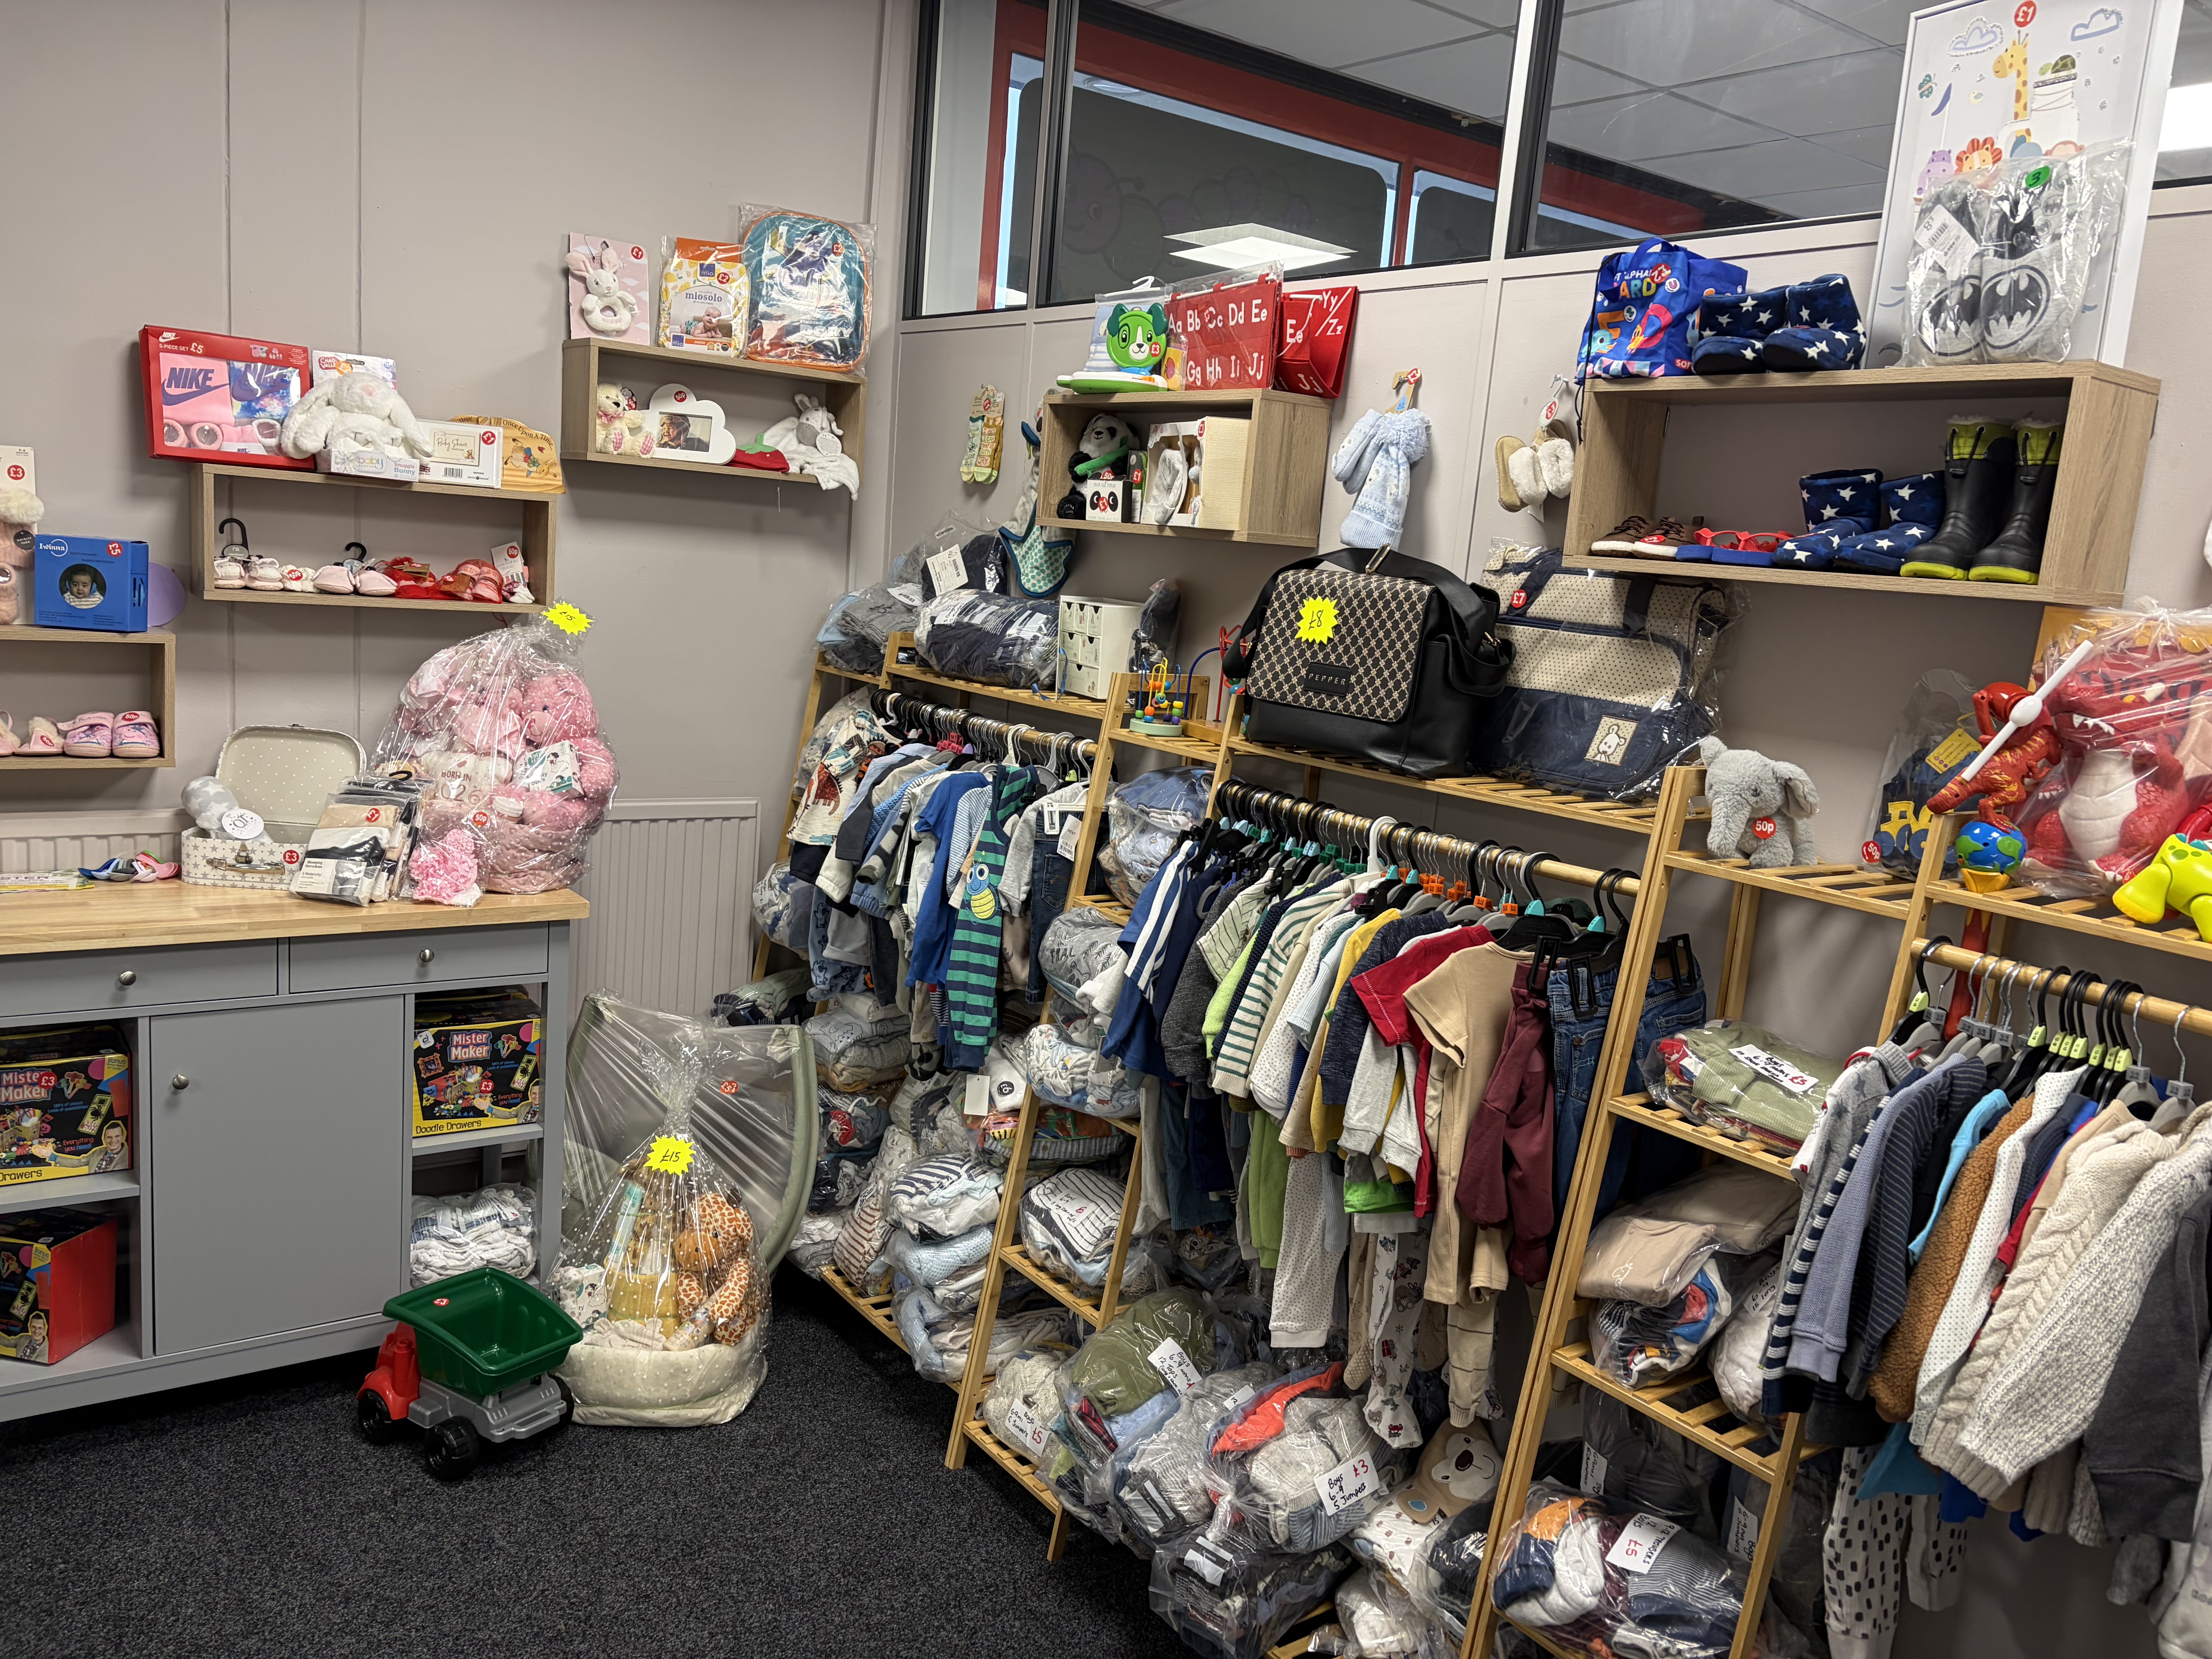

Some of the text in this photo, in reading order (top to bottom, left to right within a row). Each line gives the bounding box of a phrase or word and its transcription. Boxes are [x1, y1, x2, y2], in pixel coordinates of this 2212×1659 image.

[2017, 6, 2034, 22] £1
[634, 249, 641, 258] £1
[718, 274, 729, 282] £2
[1652, 264, 1671, 281] £2
[685, 291, 722, 302] miosolo
[1168, 299, 1267, 333] Aa Bb Cc Dd Ee
[1286, 319, 1303, 343] Ee
[1326, 319, 1343, 335] Zz
[190, 342, 203, 354] £5
[1151, 344, 1159, 354] £3
[1187, 353, 1264, 386] Gg Hh Ii Jj
[167, 367, 215, 389] NIKE
[1297, 374, 1323, 393] Jj
[675, 392, 686, 401] 50p
[503, 419, 518, 429] Once
[518, 426, 533, 438] Upon
[1199, 423, 1204, 434] £3
[436, 437, 450, 451] Baby
[483, 433, 495, 443] £1
[358, 456, 383, 470] baby
[977, 457, 989, 465] CRY
[10, 467, 22, 477] £3
[394, 468, 415, 476] Bunny
[1133, 473, 1141, 481] £1
[1099, 499, 1108, 510] £1
[109, 543, 121, 555] £5
[508, 548, 518, 556] 50p
[1513, 592, 1526, 604] £7
[1308, 609, 1324, 631] £8
[1309, 673, 1345, 685] PEPPER
[42, 737, 53, 745] 50p
[441, 770, 471, 781] BORN IN
[368, 810, 379, 821] £1
[475, 814, 487, 823] 50p
[1067, 828, 1076, 836] NEXT
[1755, 821, 1774, 834] 50p
[285, 852, 297, 860] £3
[453, 1032, 489, 1045] Mister
[451, 1046, 489, 1061] Maker
[2, 1070, 41, 1084] Miste
[41, 1076, 55, 1086] £3
[481, 1082, 493, 1091] £3
[0, 1087, 45, 1101] Maker
[416, 1120, 481, 1134] Doodle Drawers
[660, 1149, 681, 1163] £15
[1158, 1357, 1166, 1365] 12
[1166, 1364, 1178, 1379] Tops
[1032, 1427, 1043, 1444] £5
[1353, 1459, 1369, 1478] £3
[1328, 1473, 1343, 1490] Boys
[1329, 1485, 1345, 1501] 6-9
[1333, 1500, 1340, 1511] 5
[1432, 1518, 1440, 1526] 15
[1625, 1538, 1643, 1558] £5
[1202, 1549, 1217, 1562] Contents
